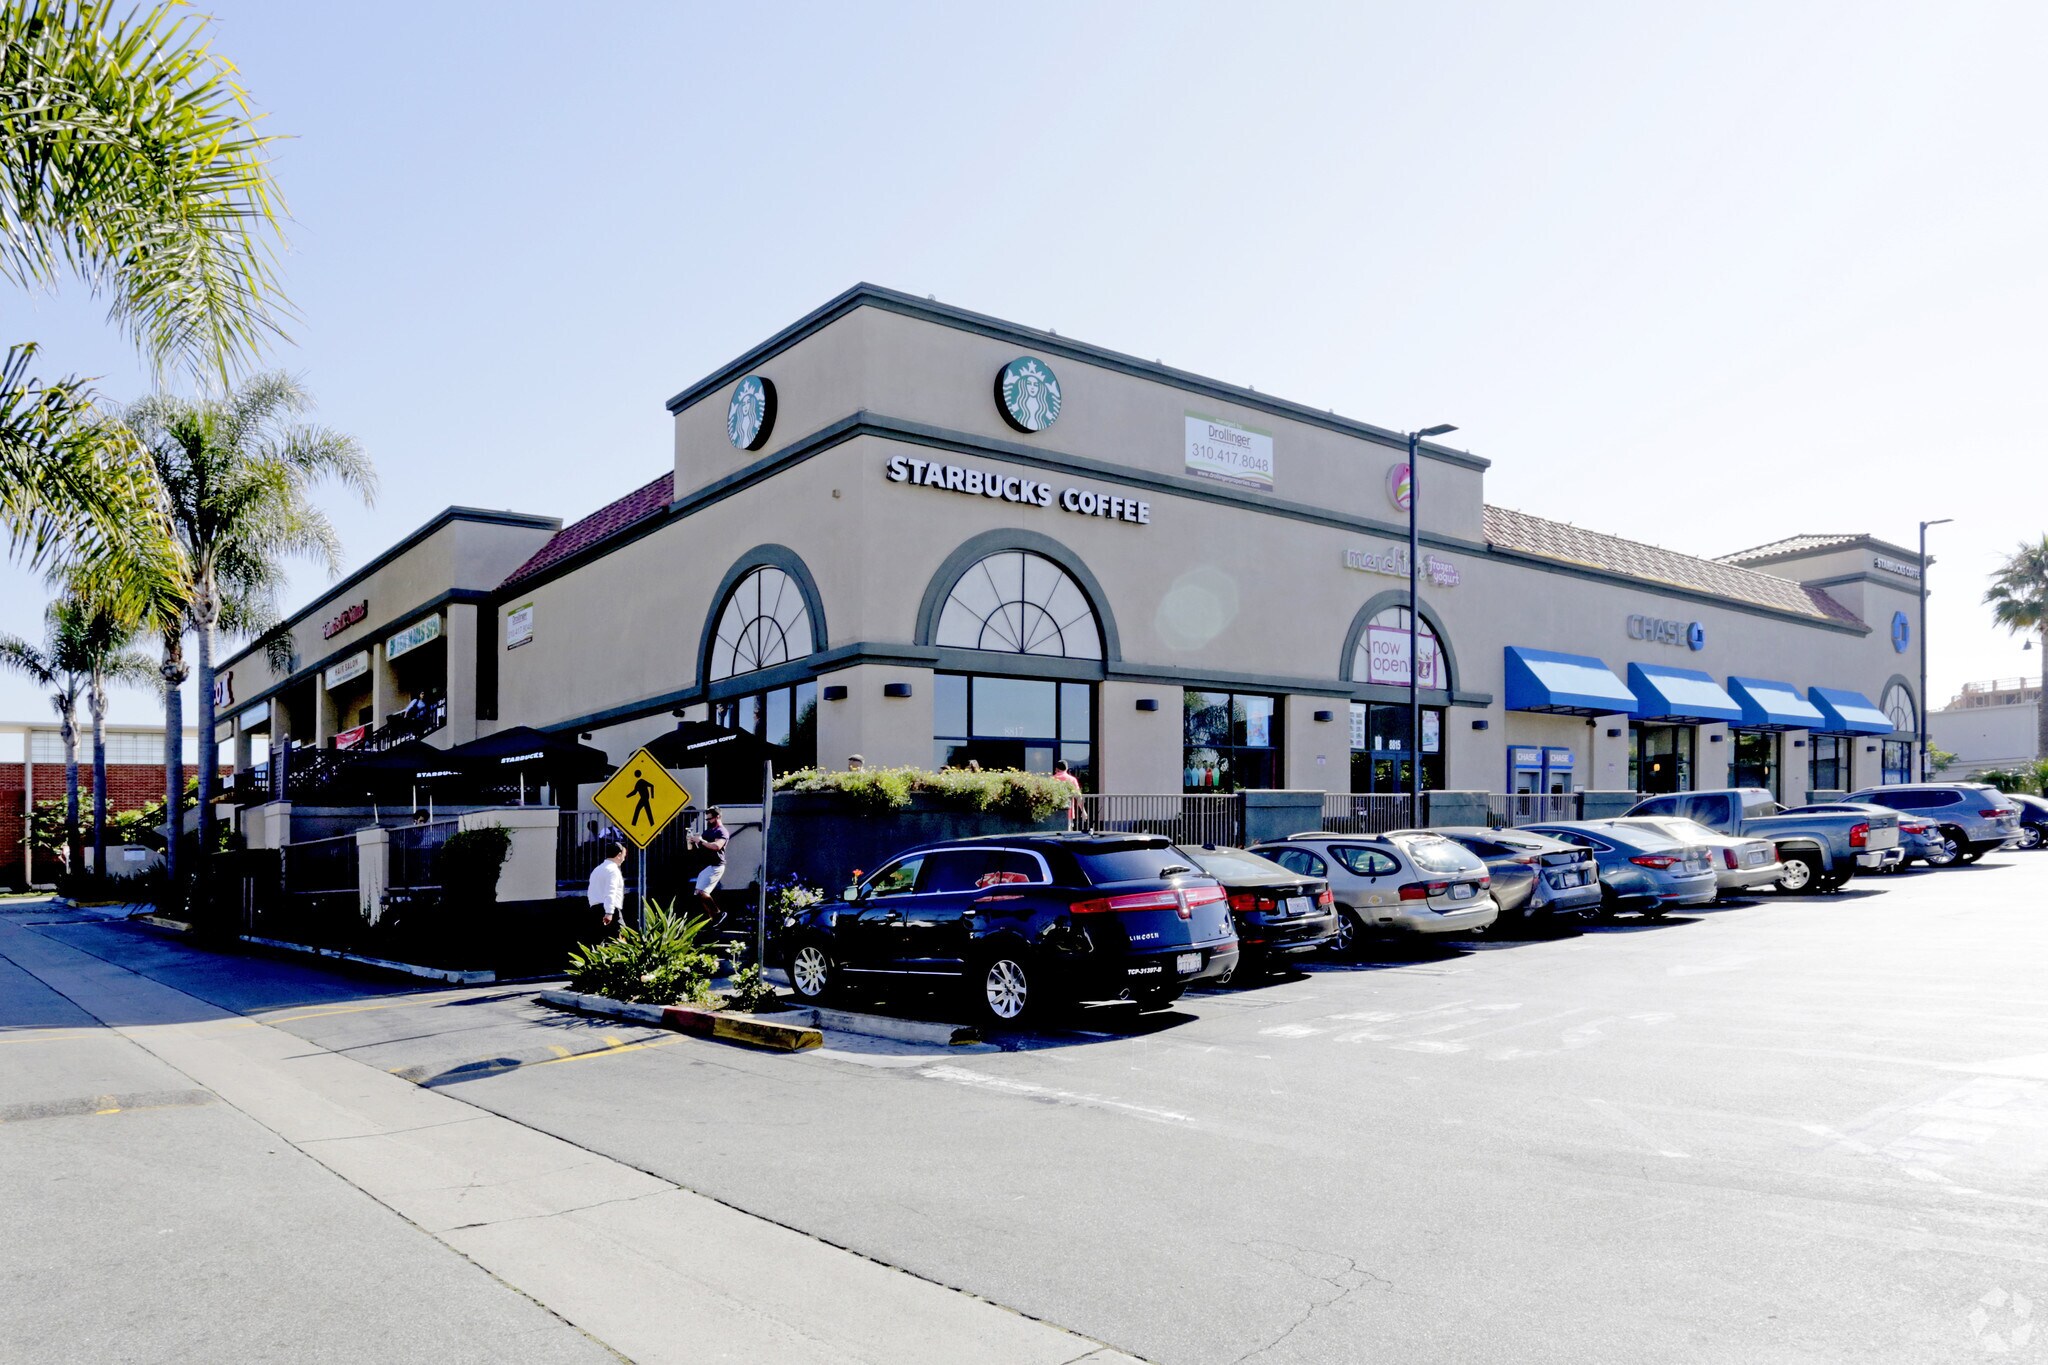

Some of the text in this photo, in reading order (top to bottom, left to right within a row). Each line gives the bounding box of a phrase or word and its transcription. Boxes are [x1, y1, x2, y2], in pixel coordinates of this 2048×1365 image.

[1208, 424, 1251, 449] Drollinger
[1192, 442, 1269, 473] 310.417.8048
[888, 455, 1151, 524] STARBUCKS COFFEE
[1428, 556, 1455, 575] frozen
[1433, 570, 1460, 585] yogurt
[1905, 566, 1921, 580] COFFE
[1627, 614, 1689, 646] CHASE
[1372, 641, 1400, 655] now
[686, 738, 718, 751] STARBUCKS
[500, 751, 544, 764] STARBUCKS
[1516, 753, 1537, 761] CHASE
[1550, 754, 1569, 763] CHASE
[416, 770, 462, 778] STARBU
[1129, 932, 1160, 942] LINCOLN
